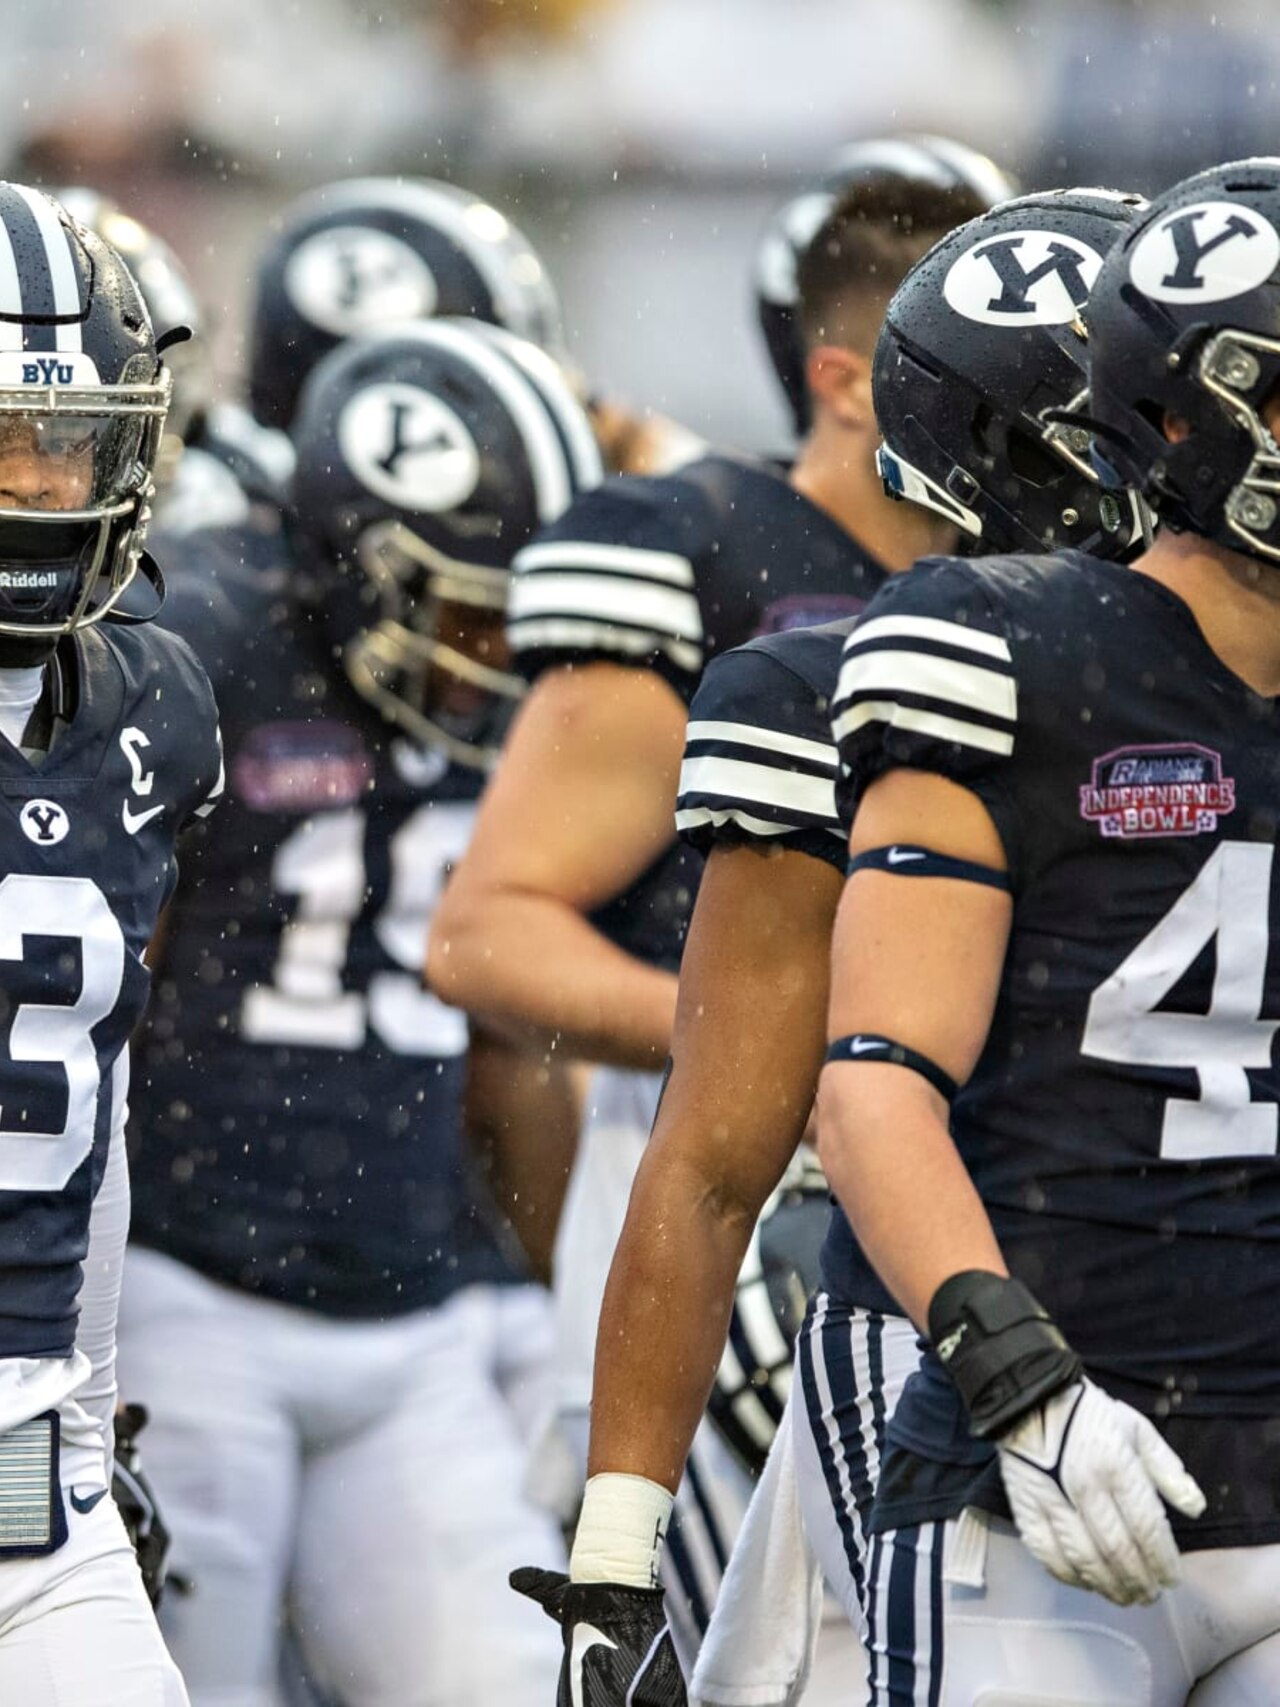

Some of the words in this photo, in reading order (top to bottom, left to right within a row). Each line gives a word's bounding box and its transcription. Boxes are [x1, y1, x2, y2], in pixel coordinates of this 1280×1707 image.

[1160, 210, 1260, 289] Y
[22, 358, 74, 385] BYU
[375, 401, 454, 475] Y
[120, 726, 154, 796] C
[27, 805, 61, 840] Y
[1086, 783, 1230, 812] INDEPENDENCE
[1123, 805, 1195, 830] BOWL
[1080, 840, 1280, 1160] 4
